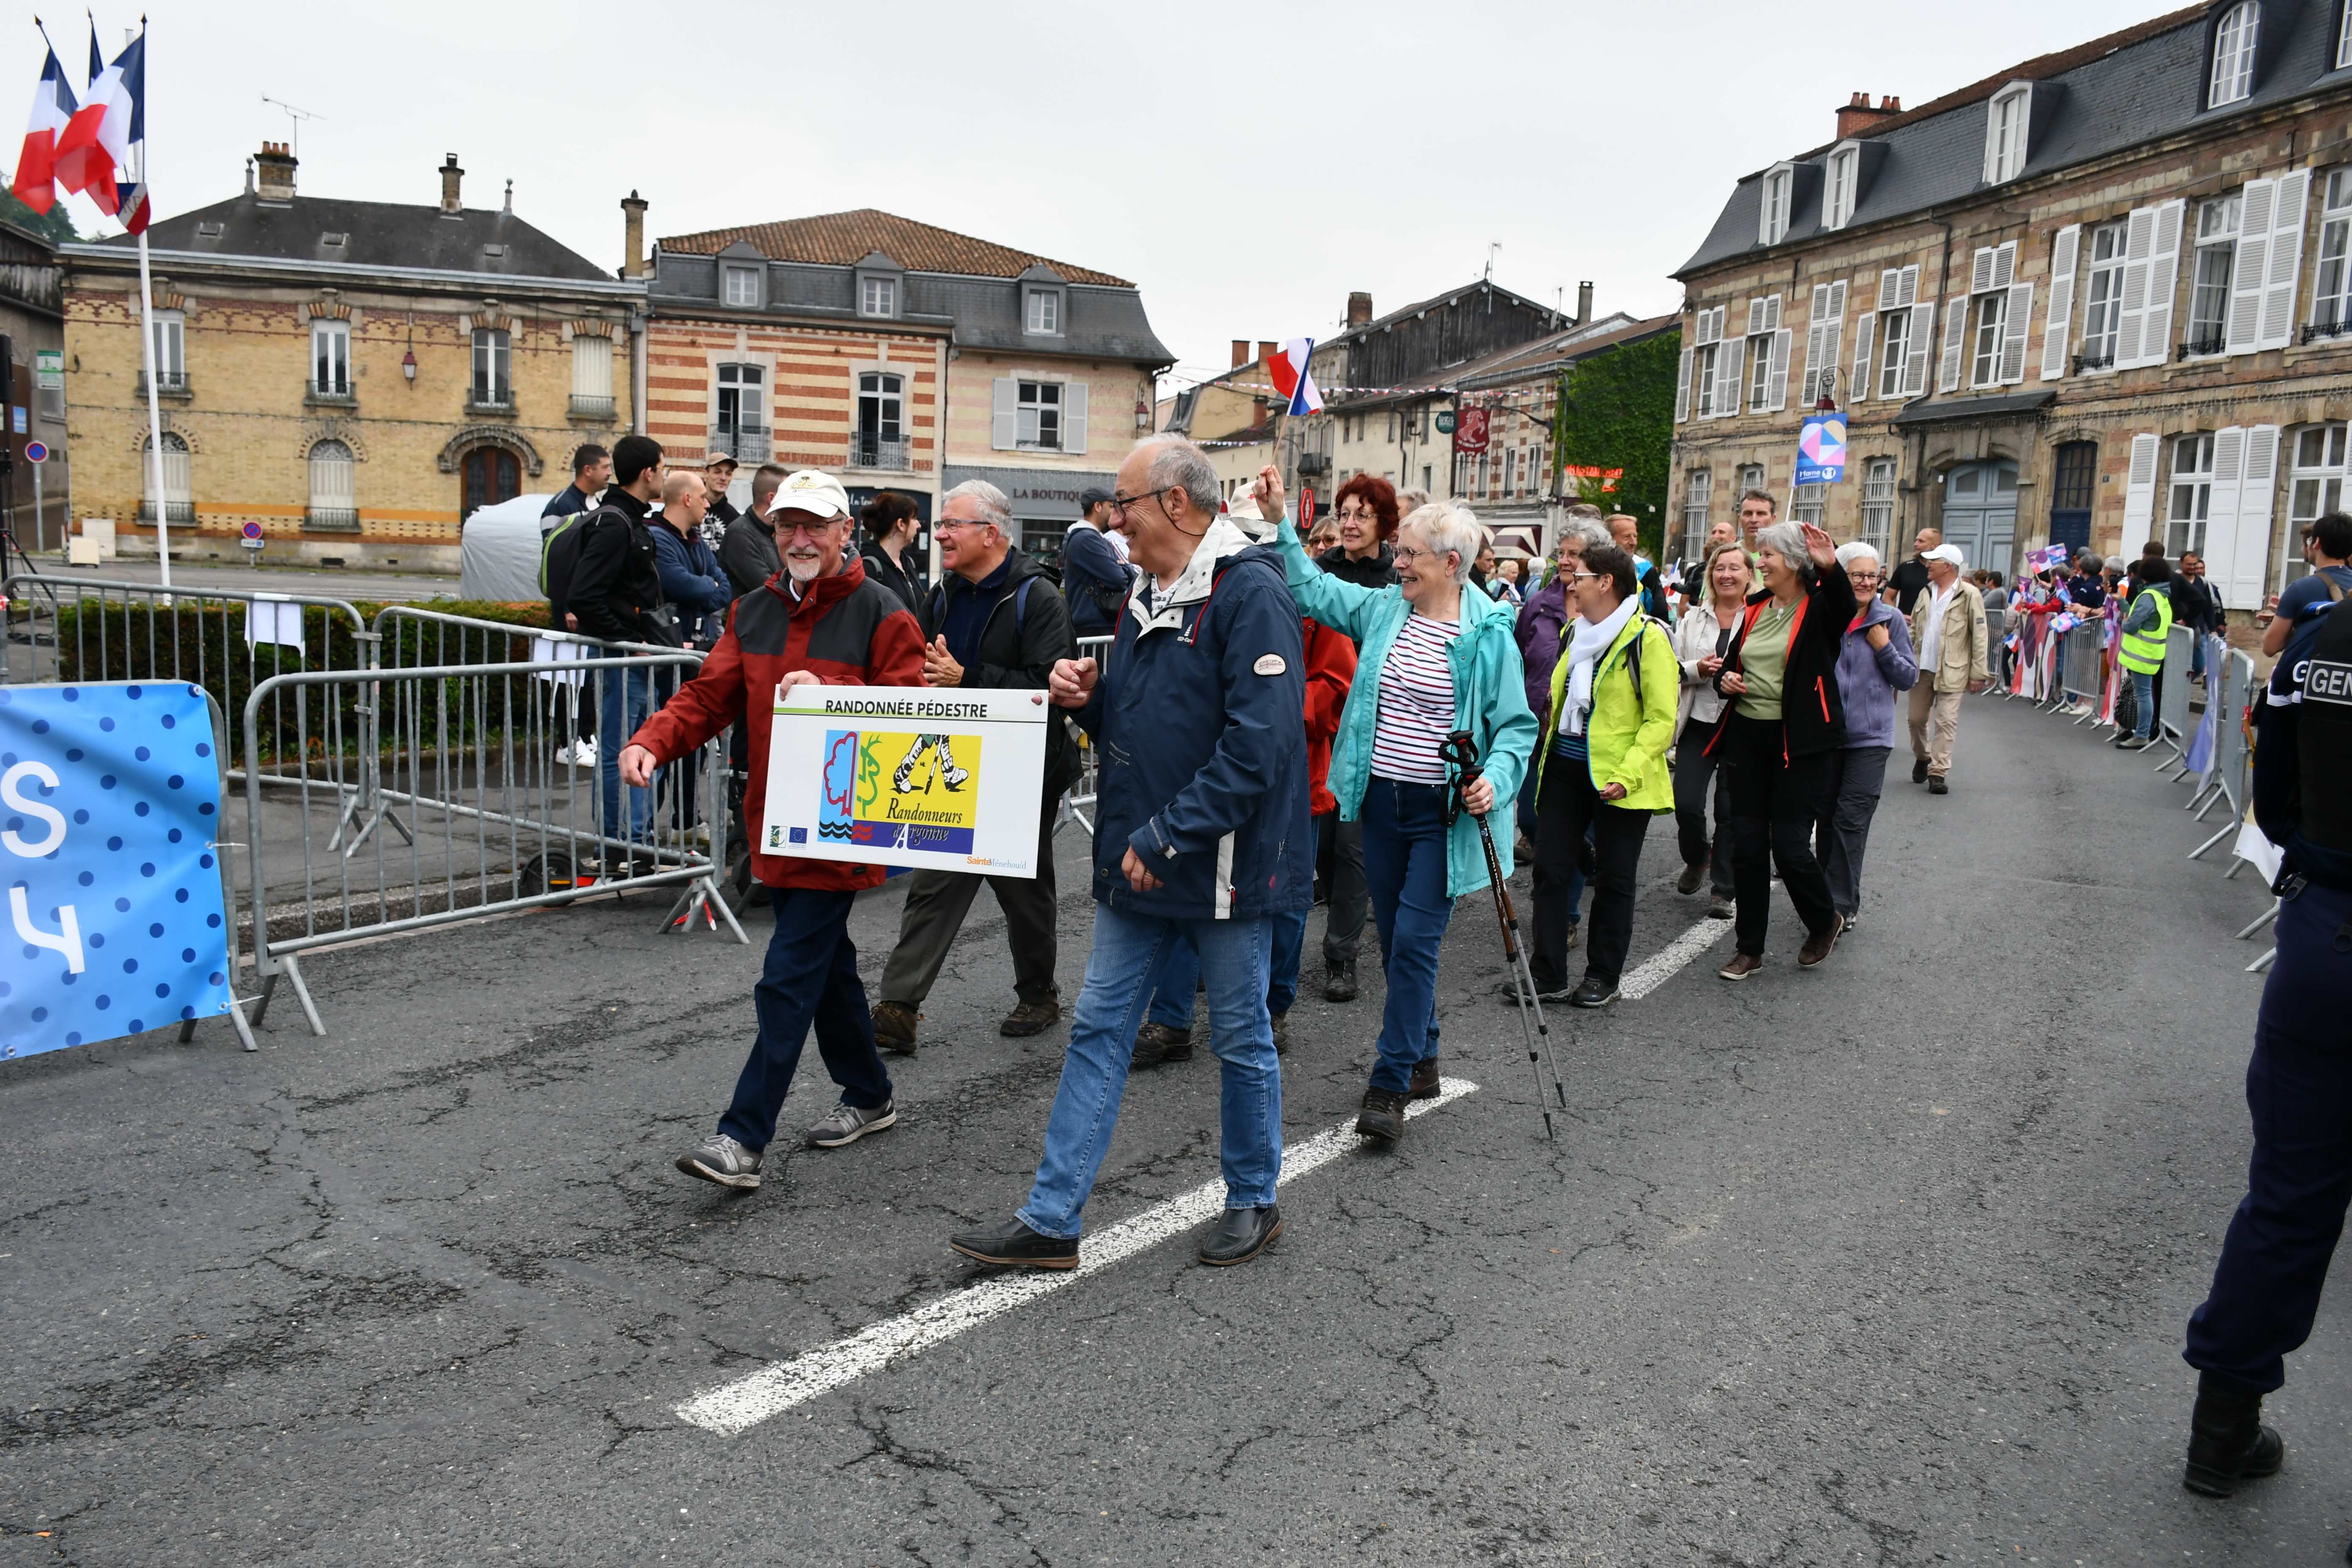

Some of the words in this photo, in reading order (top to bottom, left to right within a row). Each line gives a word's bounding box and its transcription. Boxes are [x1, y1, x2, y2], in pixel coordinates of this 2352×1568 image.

[1013, 488, 1029, 498] LA
[1032, 489, 1083, 502] BOUTIQU
[825, 699, 913, 716] RANDONNÉE
[917, 700, 988, 718] PÉDESTRE
[886, 798, 963, 824] Randonneurs
